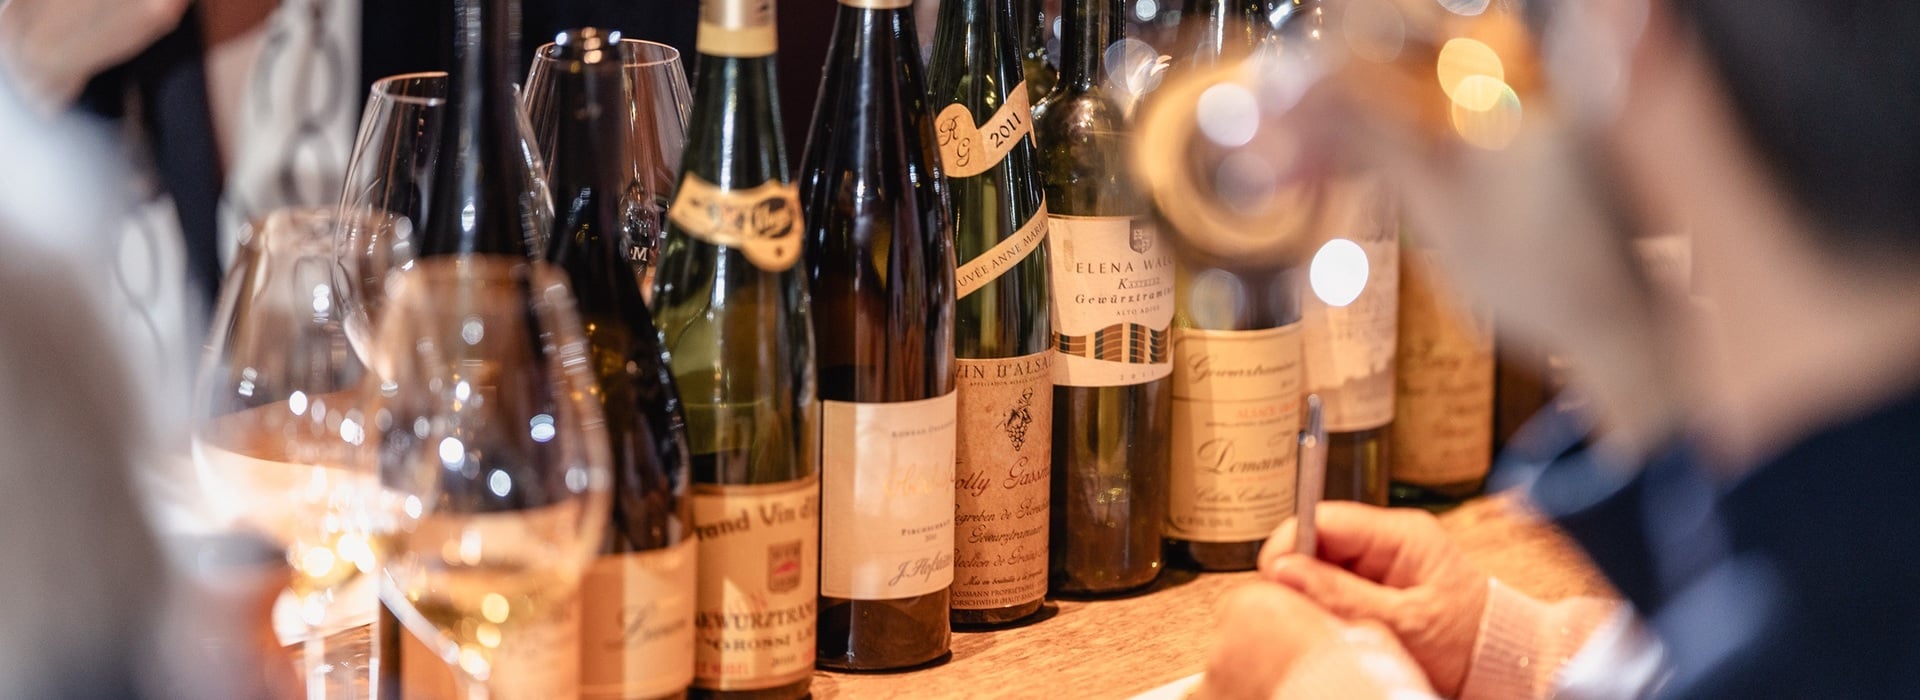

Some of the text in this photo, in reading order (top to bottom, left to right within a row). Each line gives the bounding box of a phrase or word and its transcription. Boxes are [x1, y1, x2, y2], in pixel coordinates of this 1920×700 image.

[990, 111, 1021, 149] 2011
[991, 243, 1022, 270] ANNE
[1076, 261, 1134, 275] ELENA
